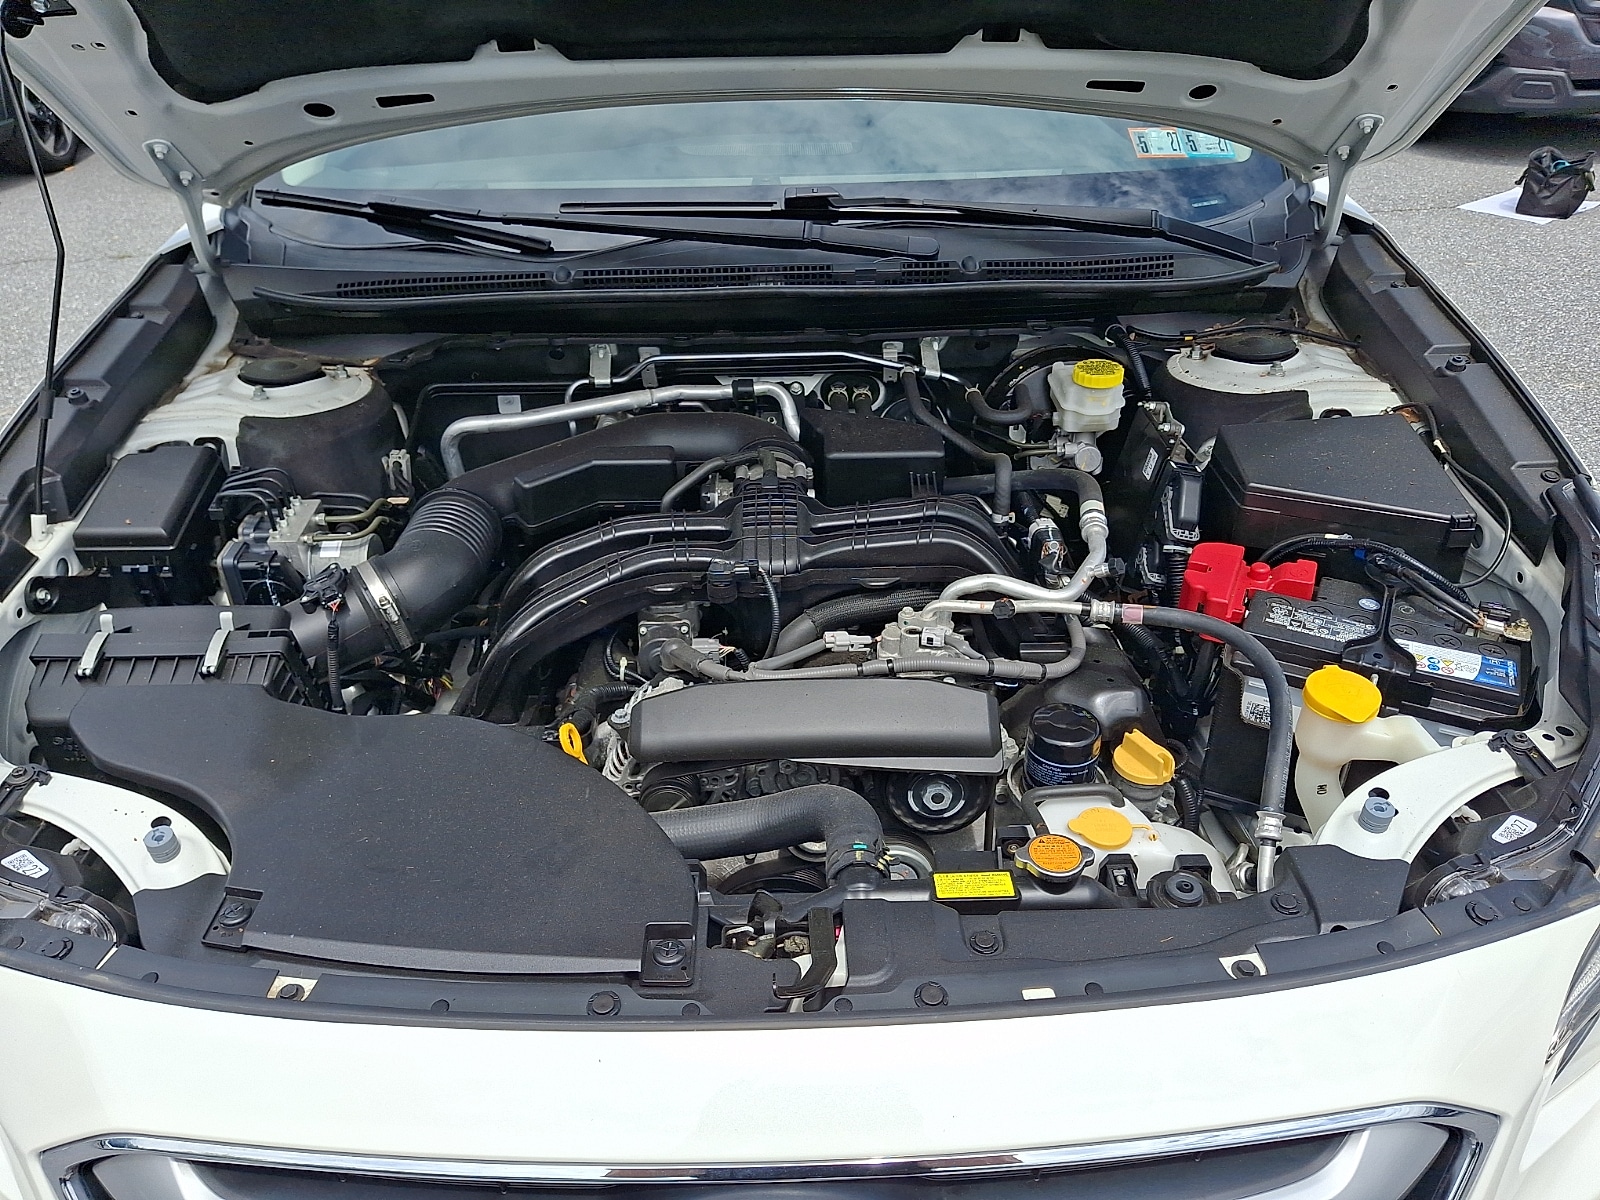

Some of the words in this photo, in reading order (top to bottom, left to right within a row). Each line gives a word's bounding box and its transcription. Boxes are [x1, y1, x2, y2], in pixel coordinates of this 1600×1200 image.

[1138, 136, 1149, 153] 5
[1166, 131, 1182, 153] 27
[1186, 135, 1198, 152] 5
[1042, 764, 1062, 772] CAUTION
[1510, 818, 1529, 832] 27
[22, 865, 43, 876] 27
